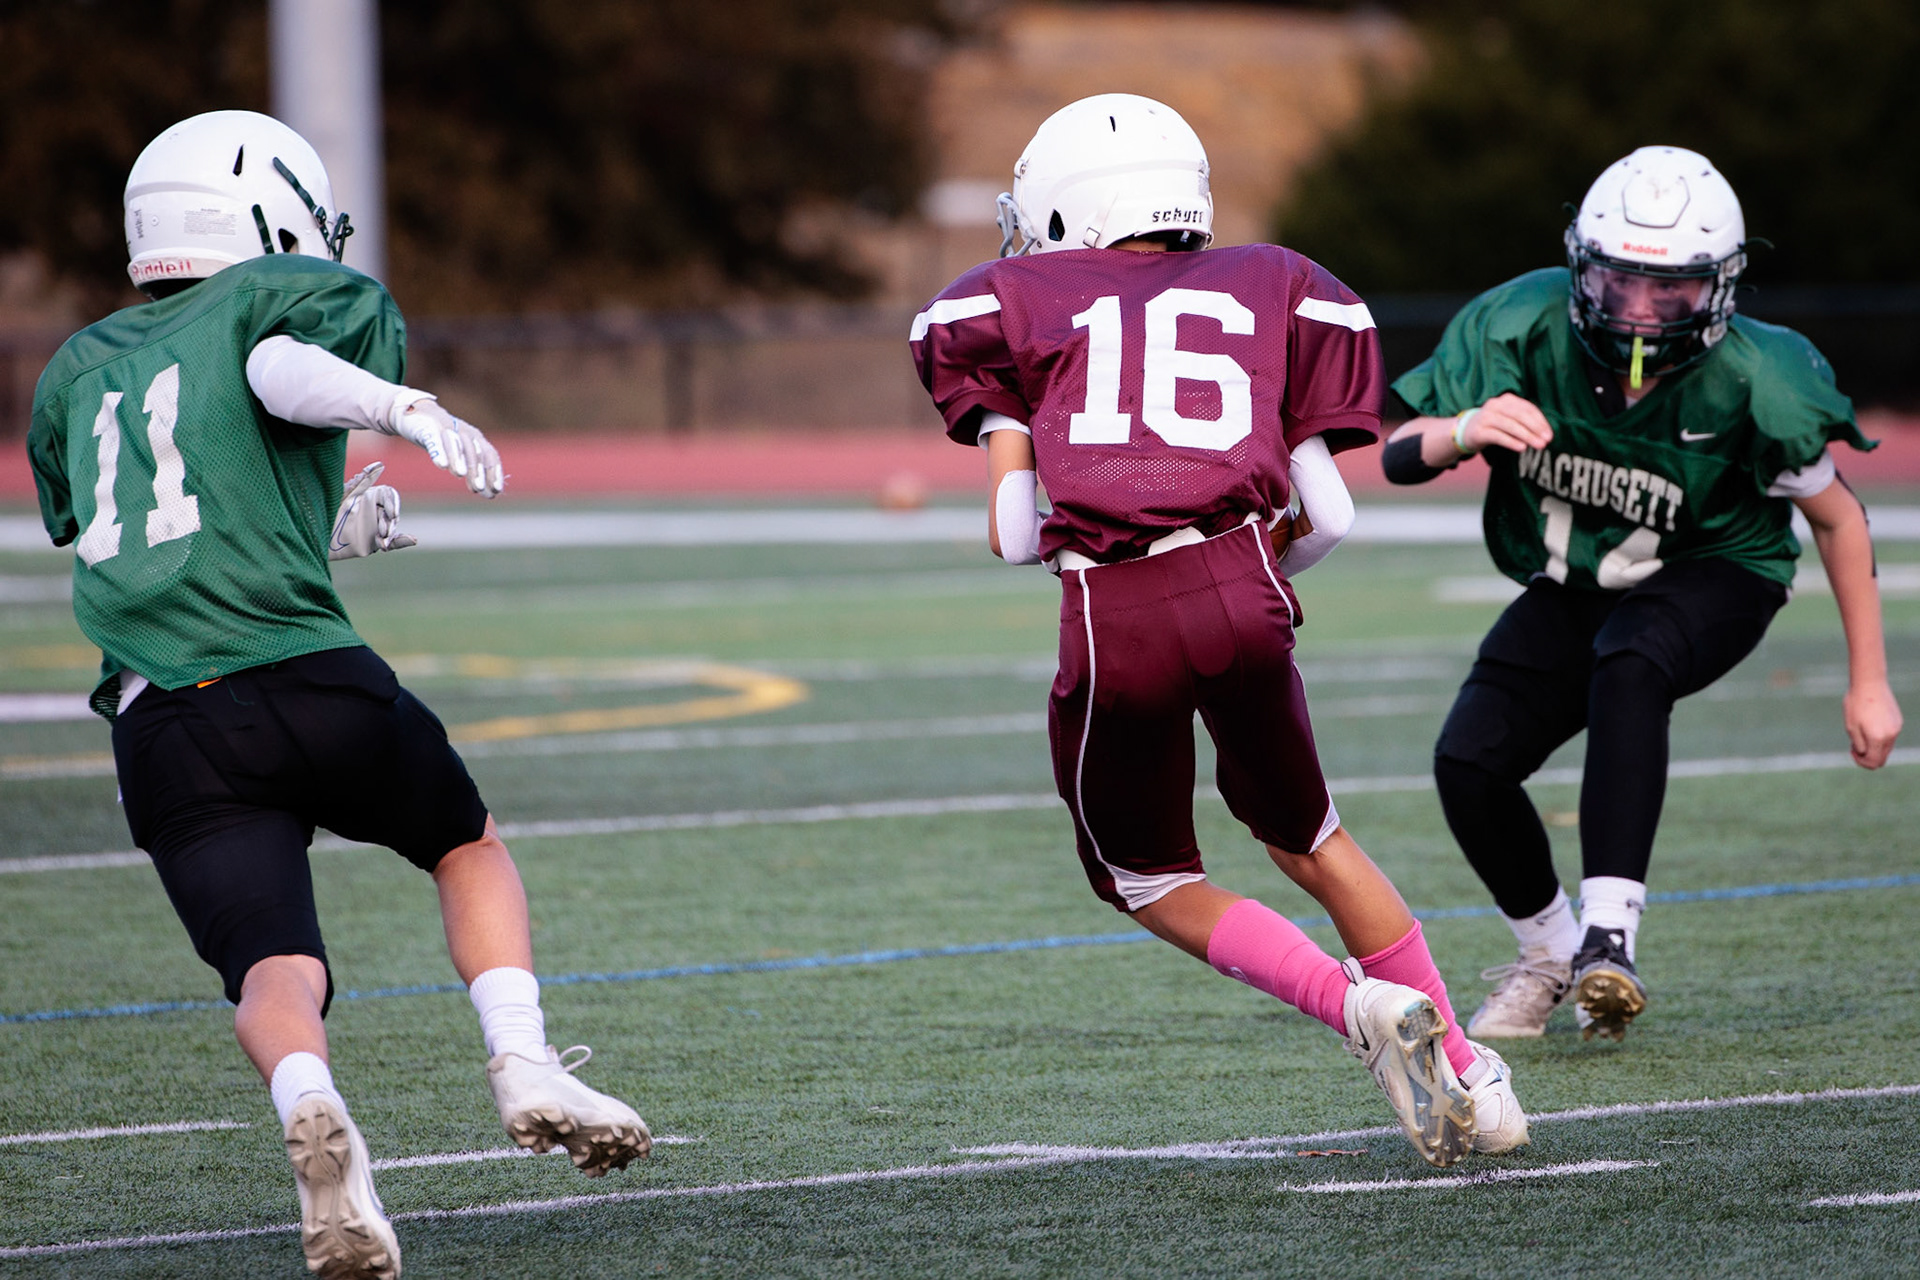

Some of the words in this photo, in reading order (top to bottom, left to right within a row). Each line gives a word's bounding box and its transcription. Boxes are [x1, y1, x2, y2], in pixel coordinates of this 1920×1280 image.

[1622, 242, 1668, 256] Riddell
[1069, 287, 1255, 452] 16
[76, 363, 201, 569] 11
[1518, 448, 1684, 532] WACHUSETT
